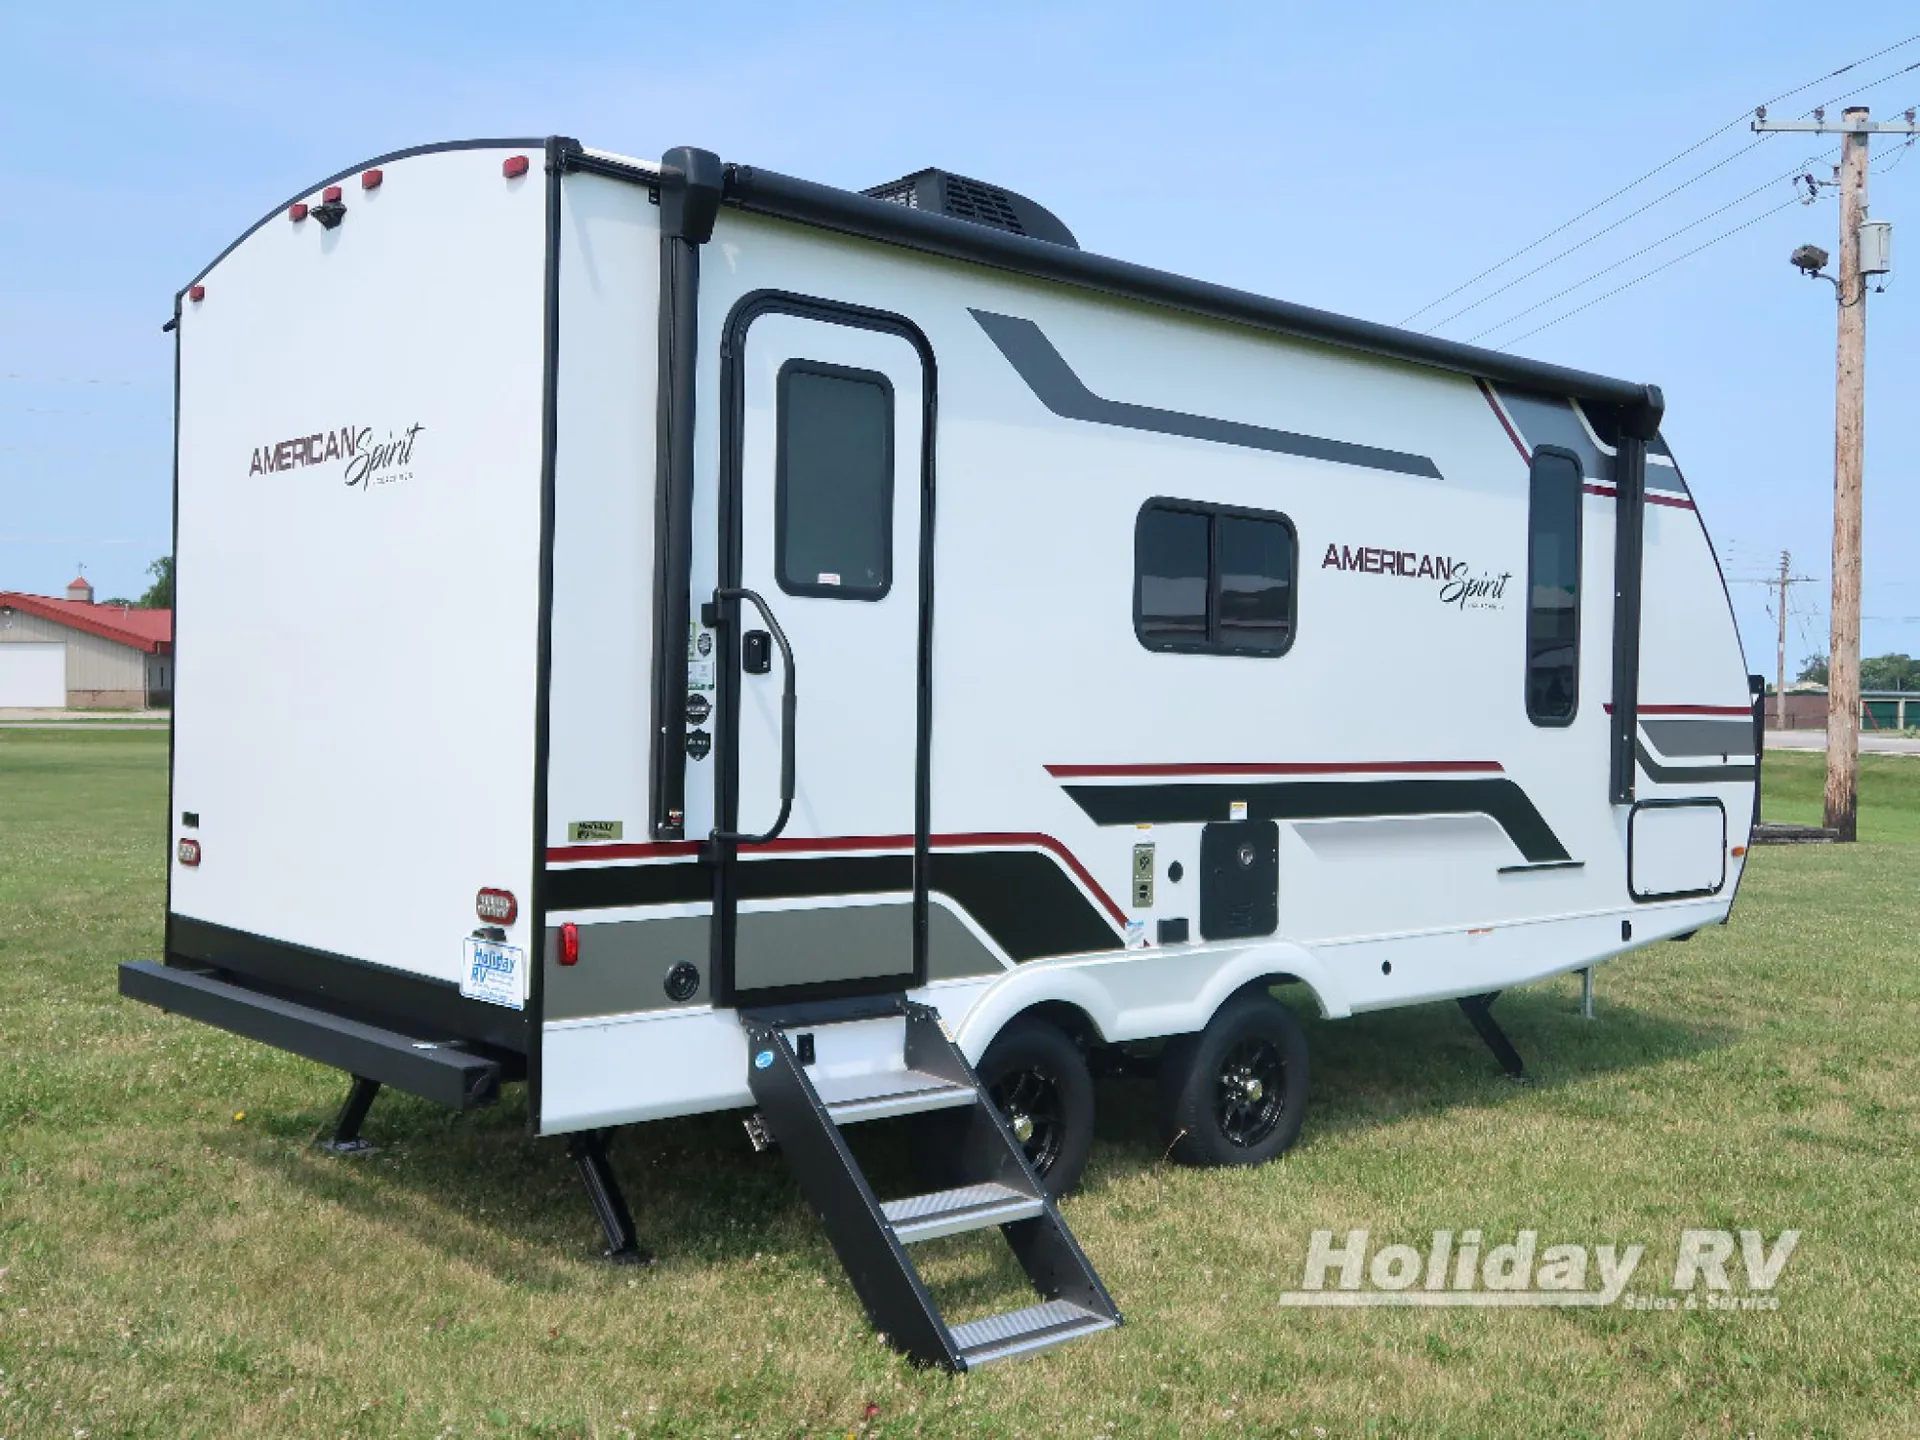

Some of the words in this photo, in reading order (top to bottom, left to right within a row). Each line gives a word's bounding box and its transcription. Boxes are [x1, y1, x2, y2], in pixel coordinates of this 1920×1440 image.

[249, 425, 355, 477] AMERICAN
[344, 422, 425, 491] Spirit
[1321, 543, 1451, 580] AMERICAN
[1440, 562, 1512, 610] Spirit
[473, 947, 516, 973] Holiday
